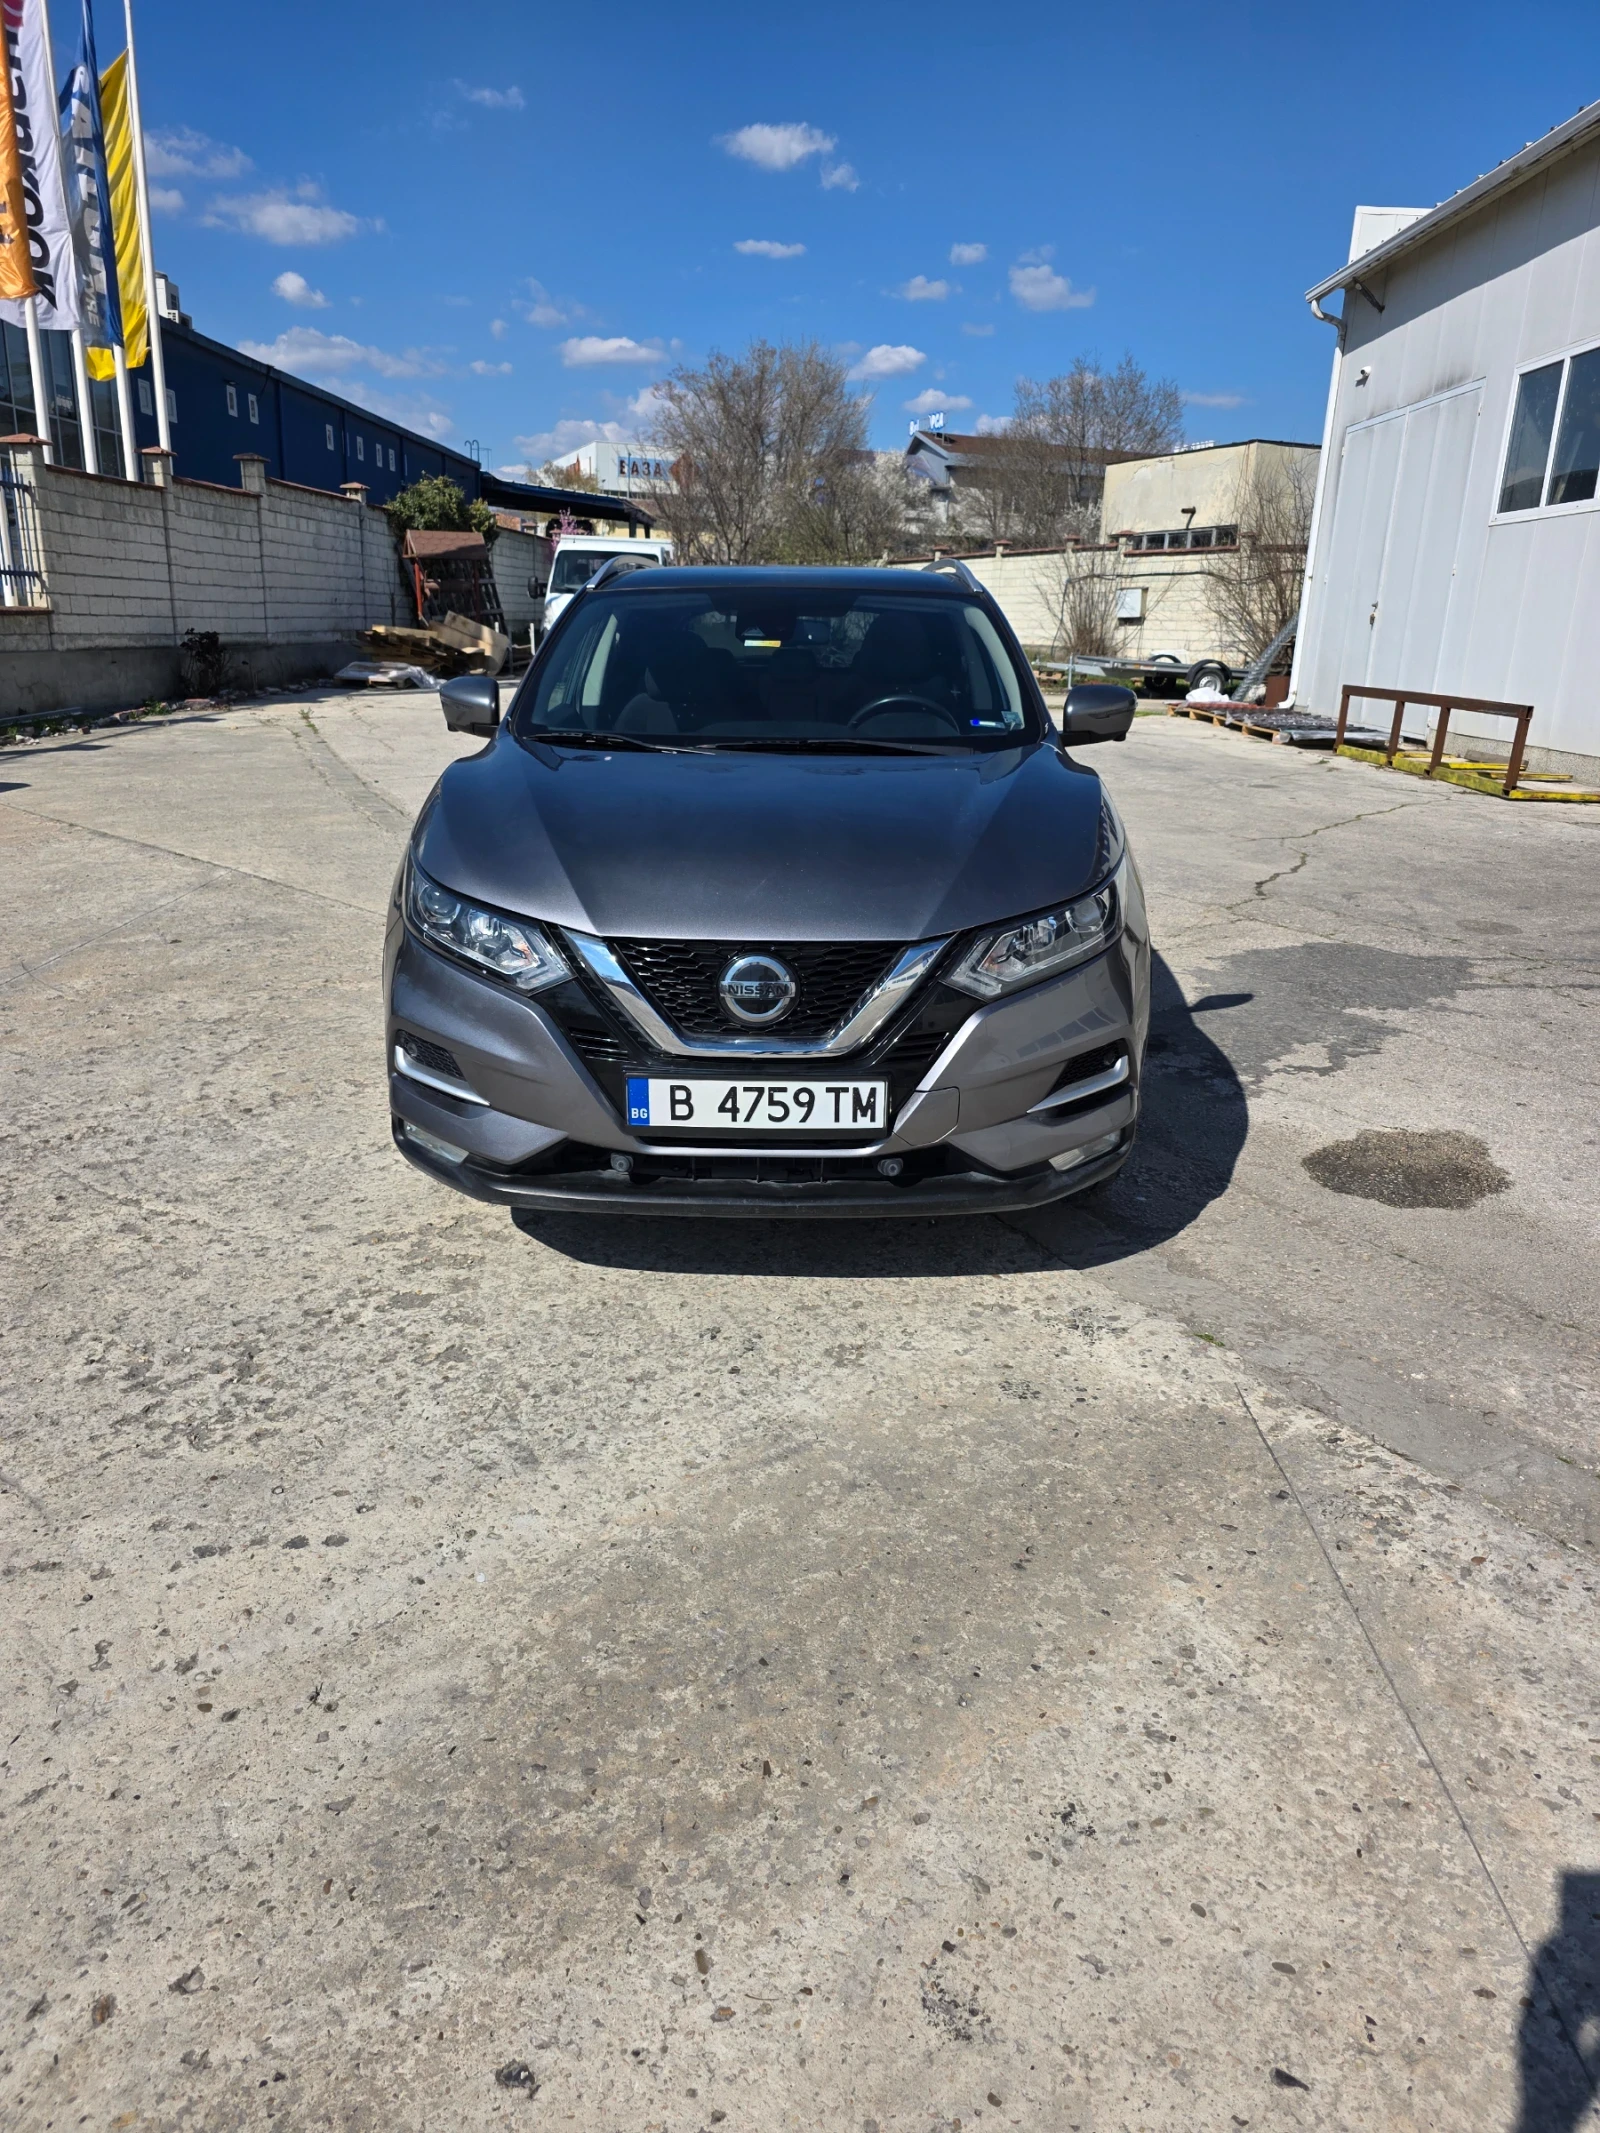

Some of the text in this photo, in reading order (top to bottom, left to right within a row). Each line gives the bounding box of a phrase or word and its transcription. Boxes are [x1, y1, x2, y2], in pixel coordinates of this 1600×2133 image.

[727, 984, 789, 996] NISSAN
[669, 1085, 877, 1123] B 4759 TM
[631, 1108, 648, 1119] BG
